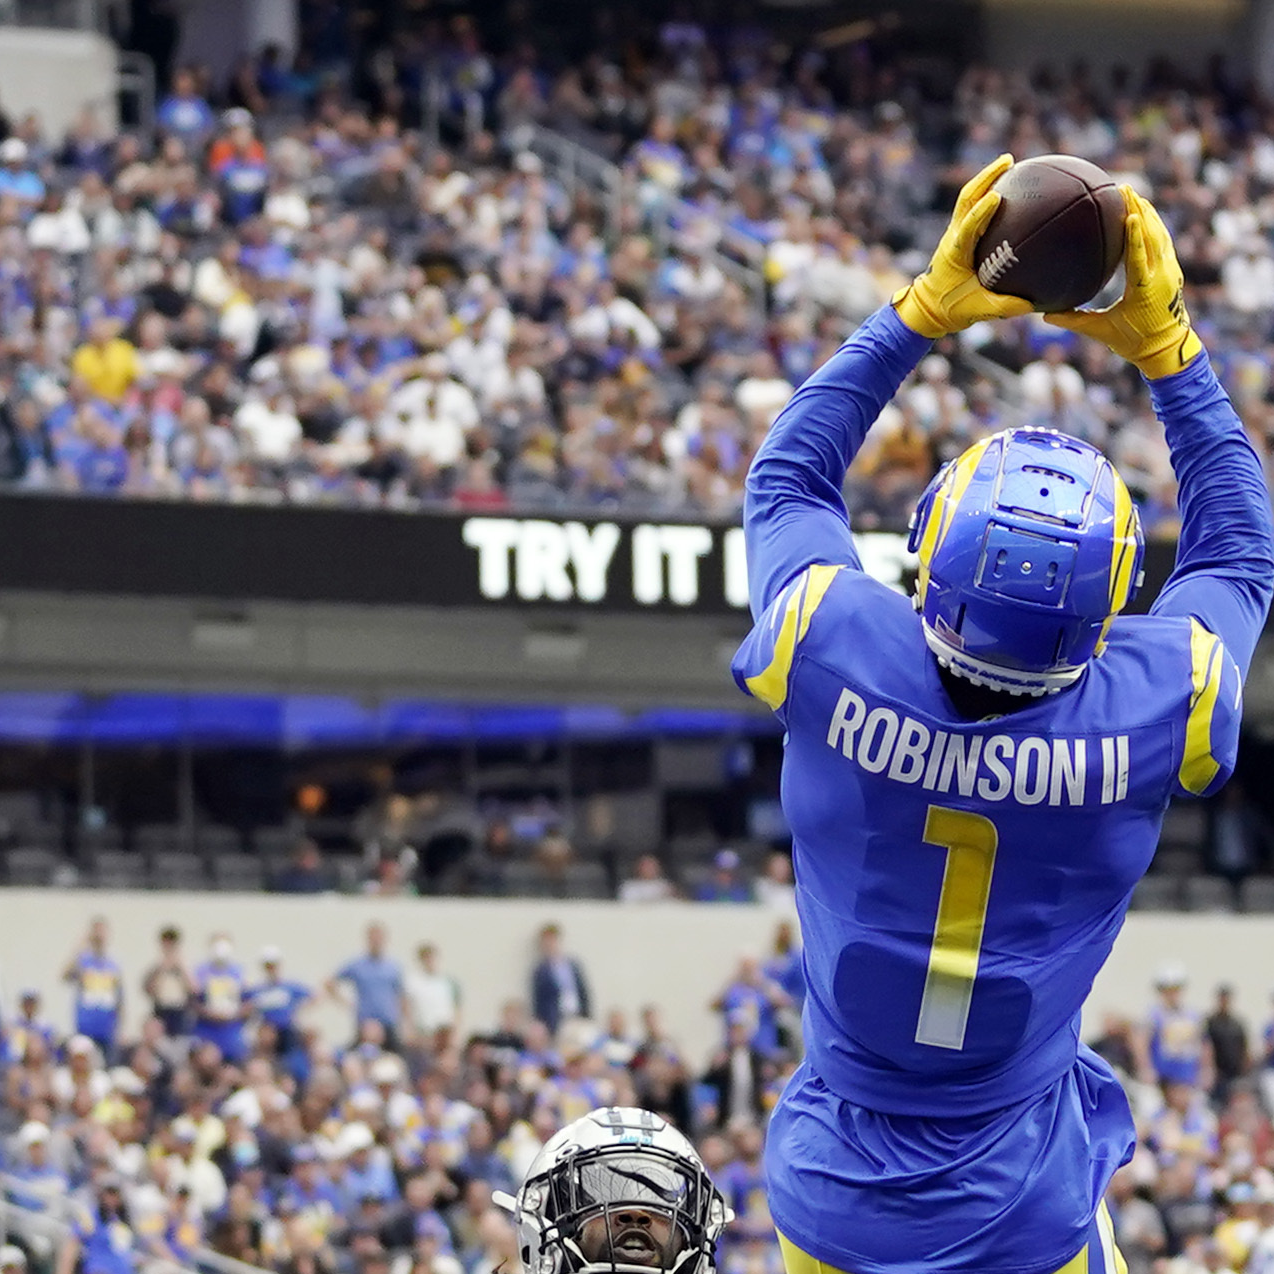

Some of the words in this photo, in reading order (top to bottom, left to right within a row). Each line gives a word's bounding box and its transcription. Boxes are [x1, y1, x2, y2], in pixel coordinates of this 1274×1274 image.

[462, 516, 621, 601] TRY
[631, 523, 713, 607] IT
[827, 687, 1087, 807] ROBINSON
[1100, 734, 1130, 805] II
[914, 803, 999, 1051] 1
